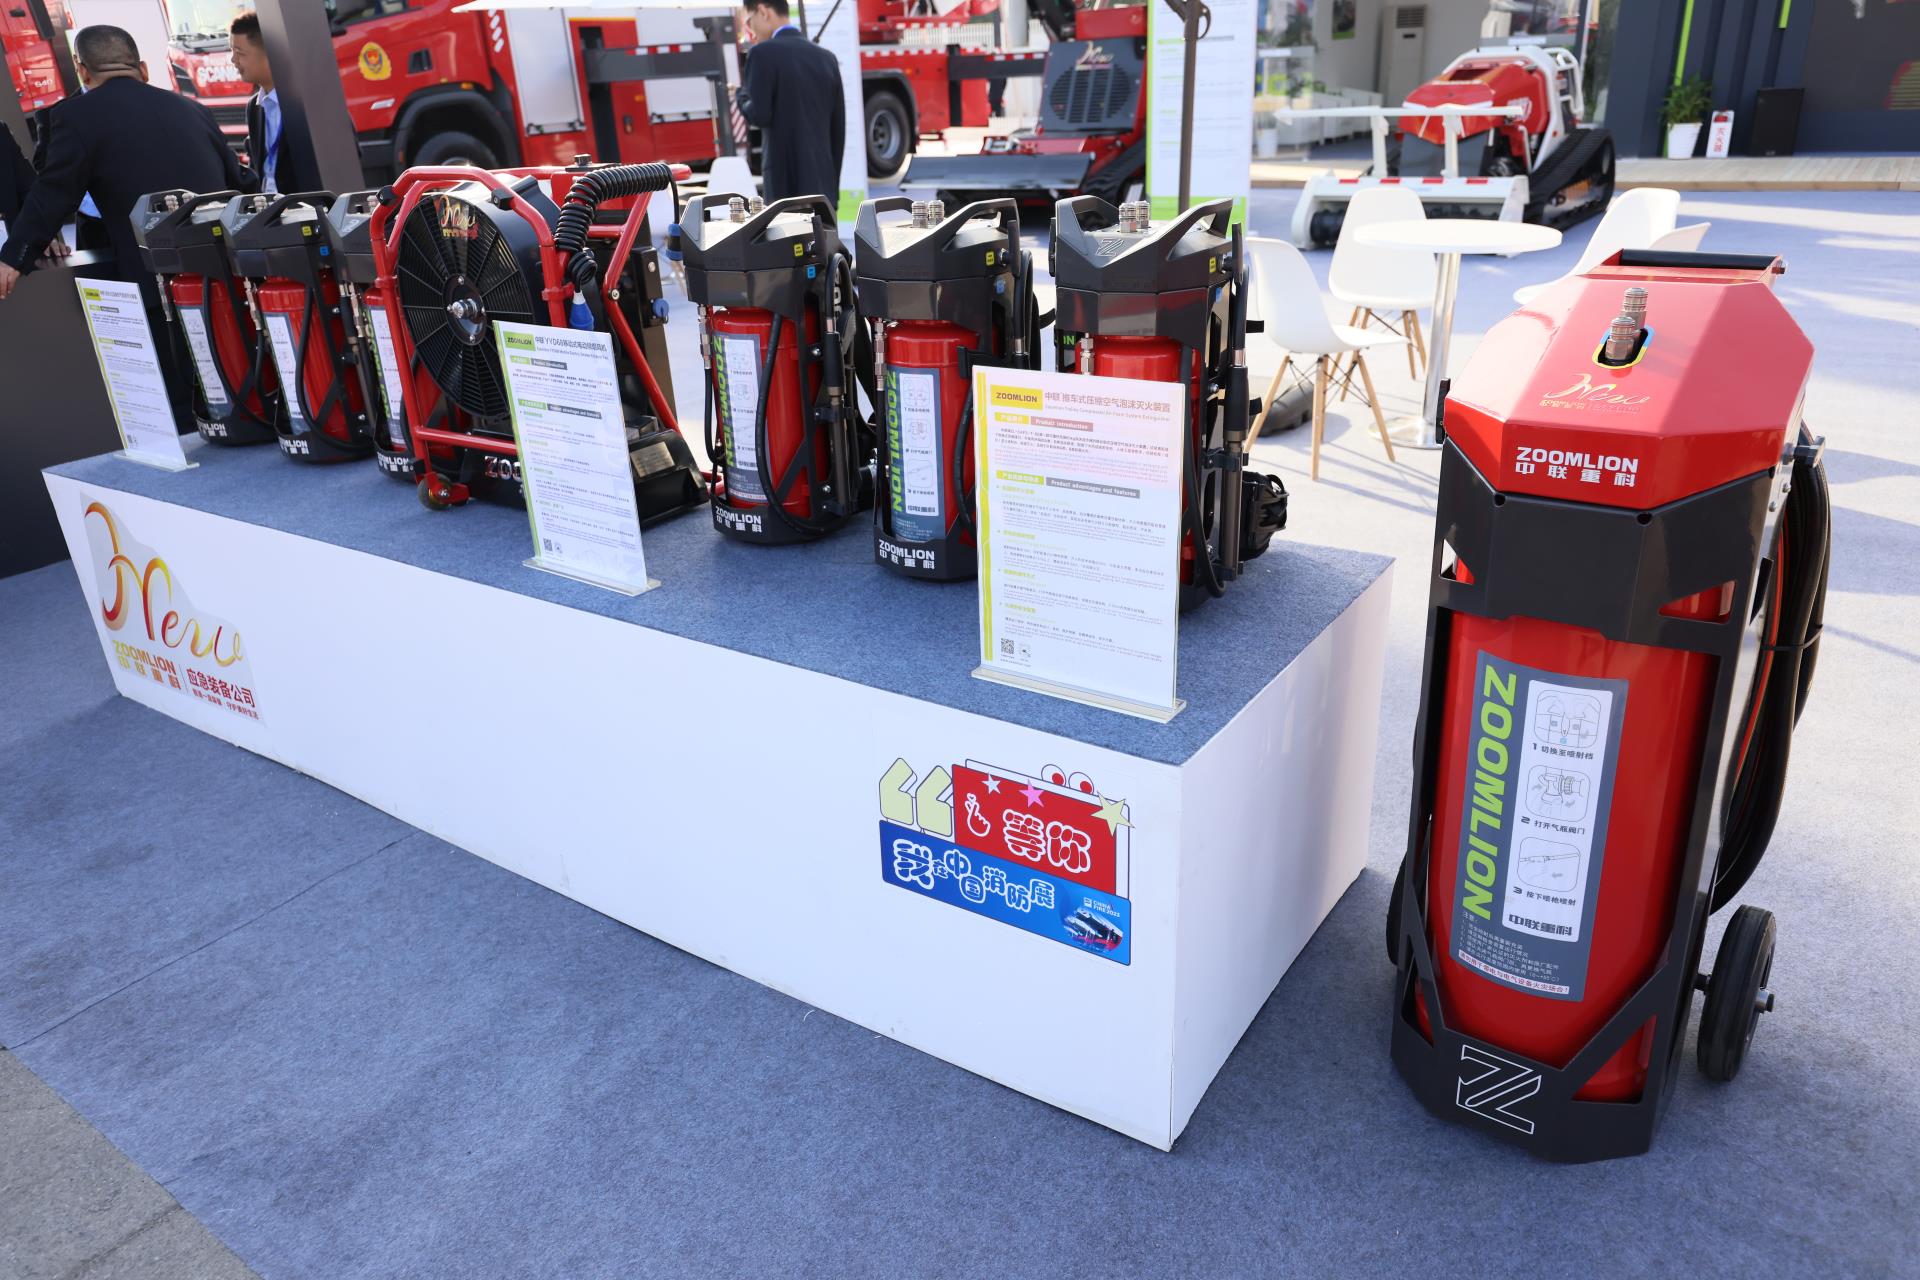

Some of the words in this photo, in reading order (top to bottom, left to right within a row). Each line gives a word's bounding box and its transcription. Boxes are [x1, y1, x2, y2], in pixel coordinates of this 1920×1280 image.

[996, 391, 1038, 403] ZOOMLION
[1543, 373, 1651, 405] New
[886, 370, 904, 512] ZOOMLION
[1516, 446, 1639, 473] ZOOMLION
[1515, 461, 1636, 487] 中联重科
[715, 505, 762, 525] ZOOMLION
[879, 538, 935, 560] ZOOMLION
[85, 502, 243, 668] New
[112, 640, 178, 677] ZOOMLION
[187, 668, 256, 708] 应急装备公司
[1533, 742, 1538, 751] 1
[1462, 664, 1517, 921] ZOOMLION
[1521, 816, 1531, 824] 2
[1534, 820, 1585, 835] 打开气瓶阀门
[1003, 808, 1092, 874] 等你
[893, 839, 1055, 913] 我在中国消防展
[1513, 886, 1523, 895] 3
[1526, 891, 1577, 906] 按下喷枪喷射
[1508, 913, 1573, 936] 中联重科
